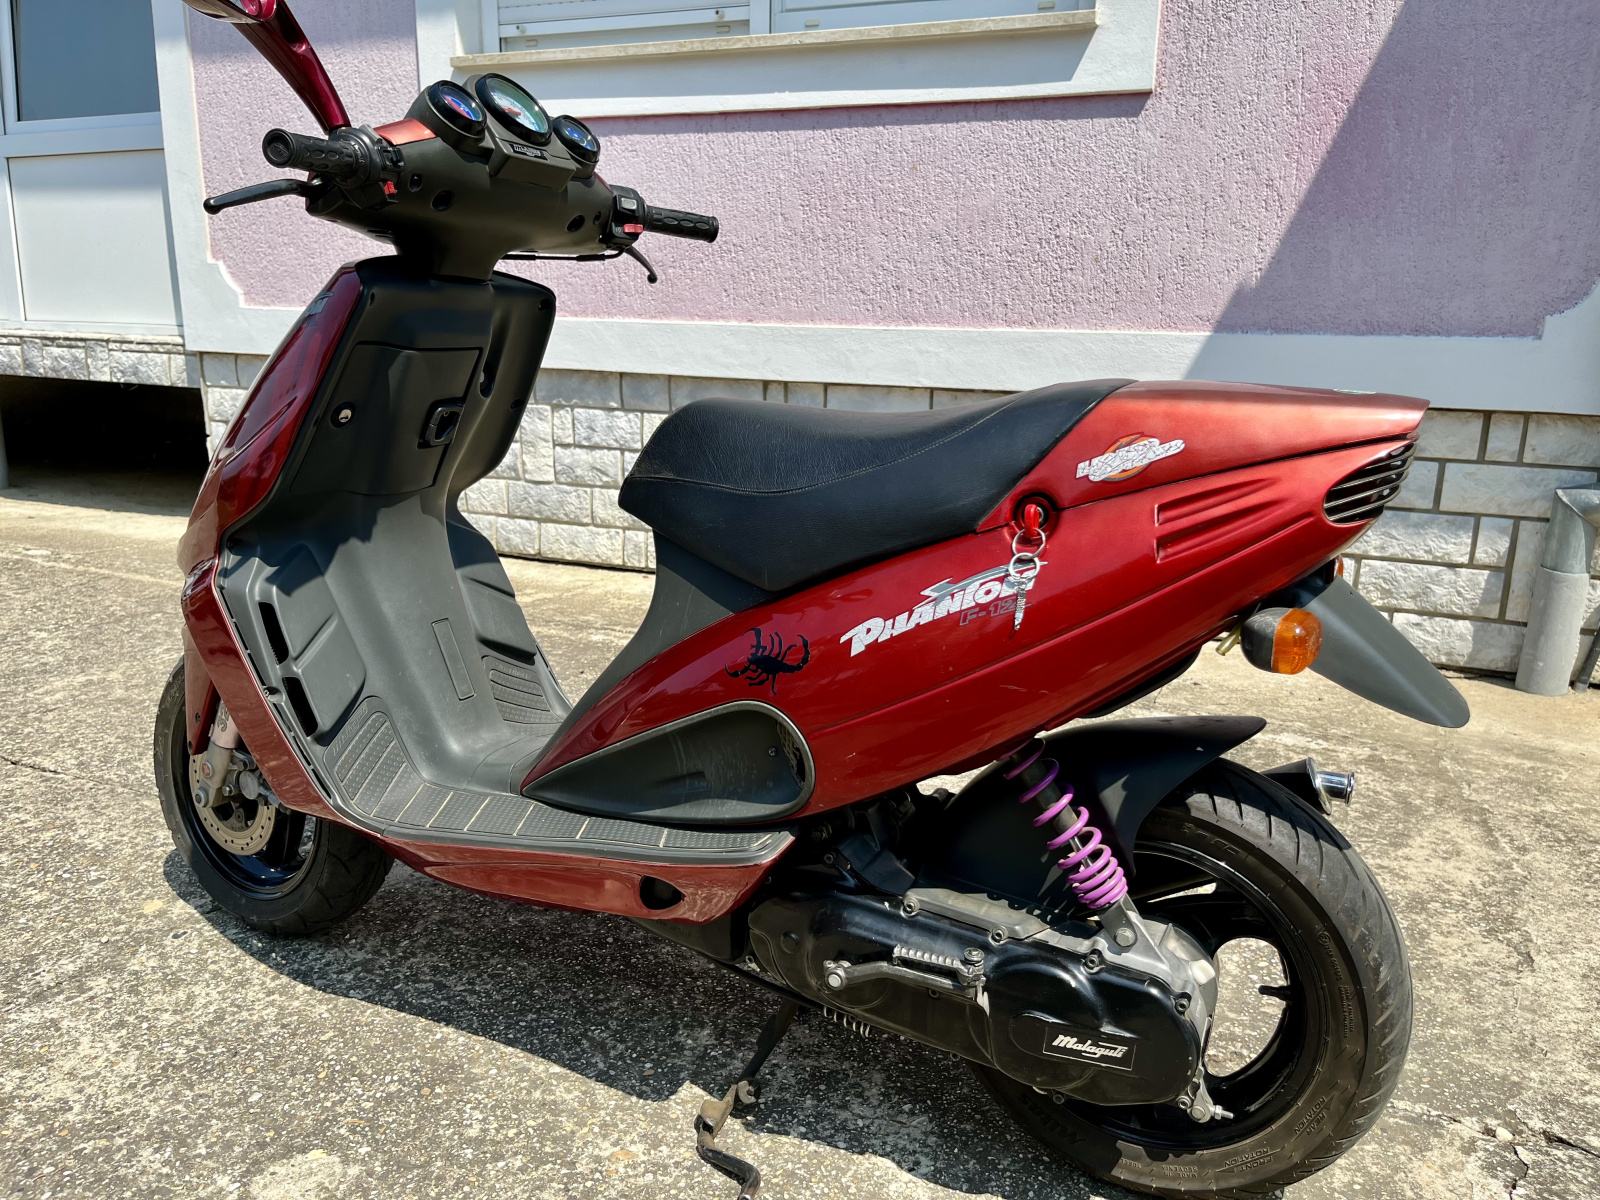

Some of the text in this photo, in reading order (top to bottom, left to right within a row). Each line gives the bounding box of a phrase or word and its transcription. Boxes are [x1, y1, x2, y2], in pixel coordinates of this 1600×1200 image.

[1052, 1034, 1128, 1058] Malaguti
[1294, 1096, 1328, 1135] ROTATION
[1223, 1147, 1270, 1167] ROTATION
[1239, 1155, 1273, 1172] FRONT
